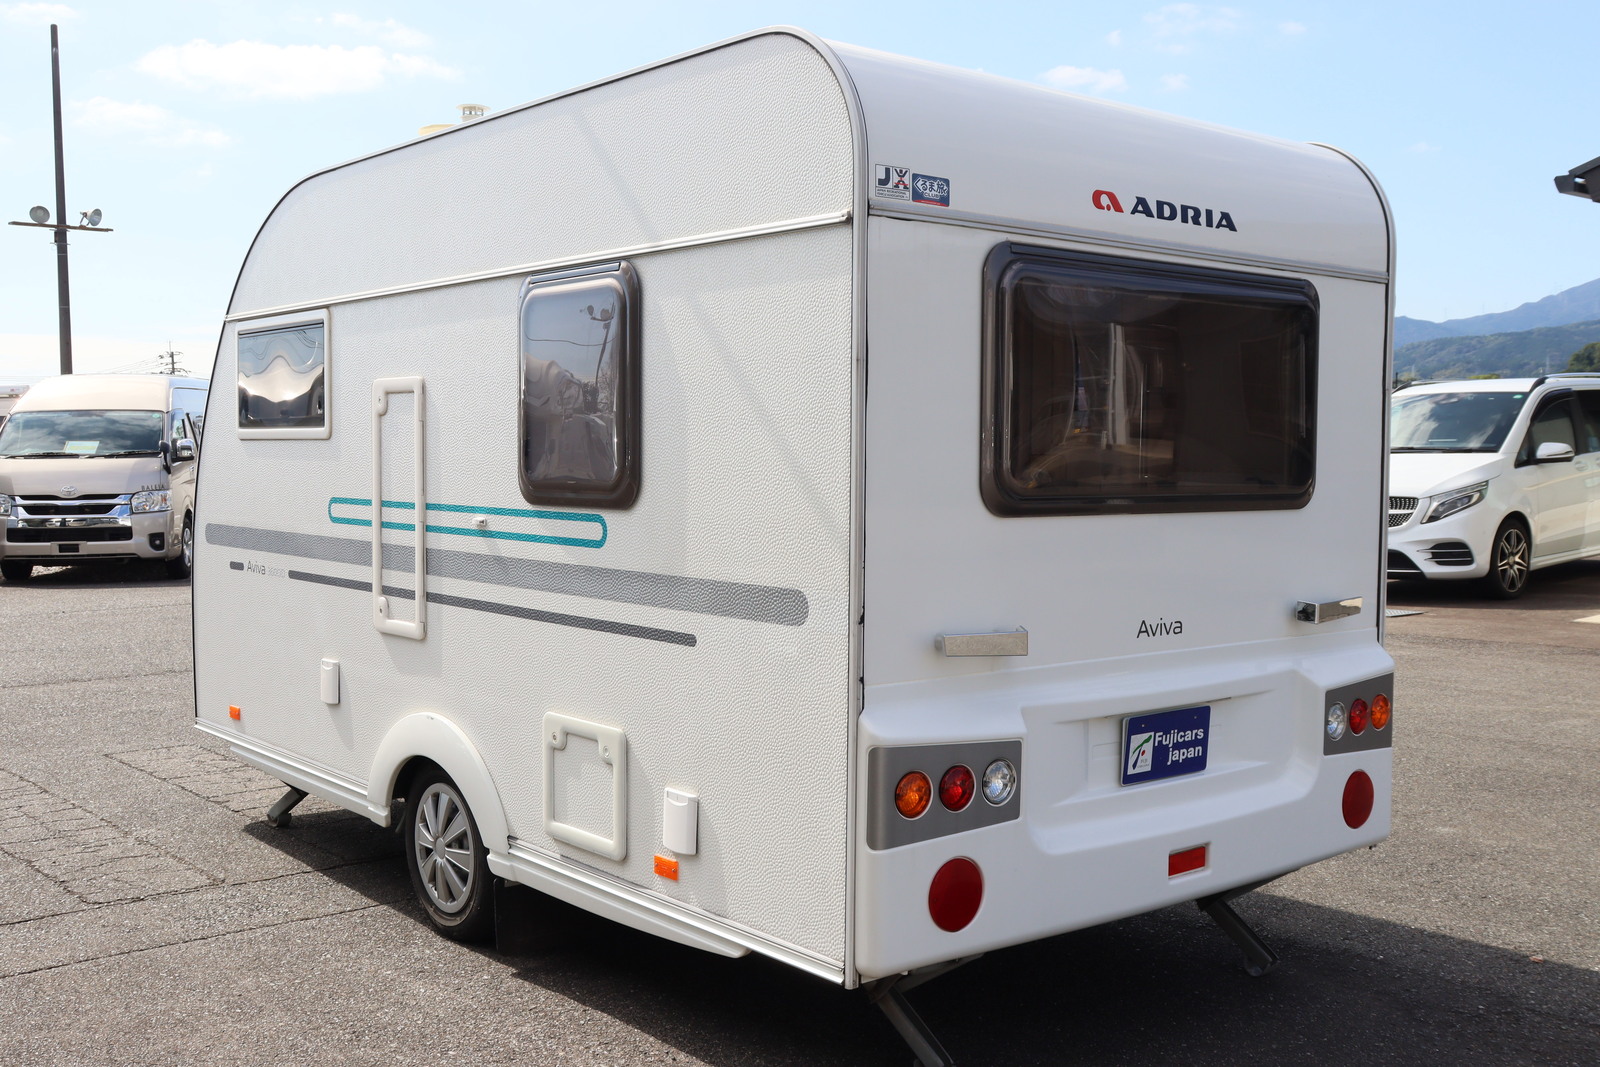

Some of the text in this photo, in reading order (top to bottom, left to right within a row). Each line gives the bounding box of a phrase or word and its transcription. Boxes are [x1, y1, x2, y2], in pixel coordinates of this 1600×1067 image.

[914, 178, 948, 196] くるま旅
[924, 191, 940, 199] CLUB
[1130, 196, 1238, 232] ADRIA
[247, 560, 266, 575] Aviva
[1136, 617, 1183, 639] Aviva
[1154, 728, 1204, 748] Fujicars
[1167, 745, 1203, 766] japan
